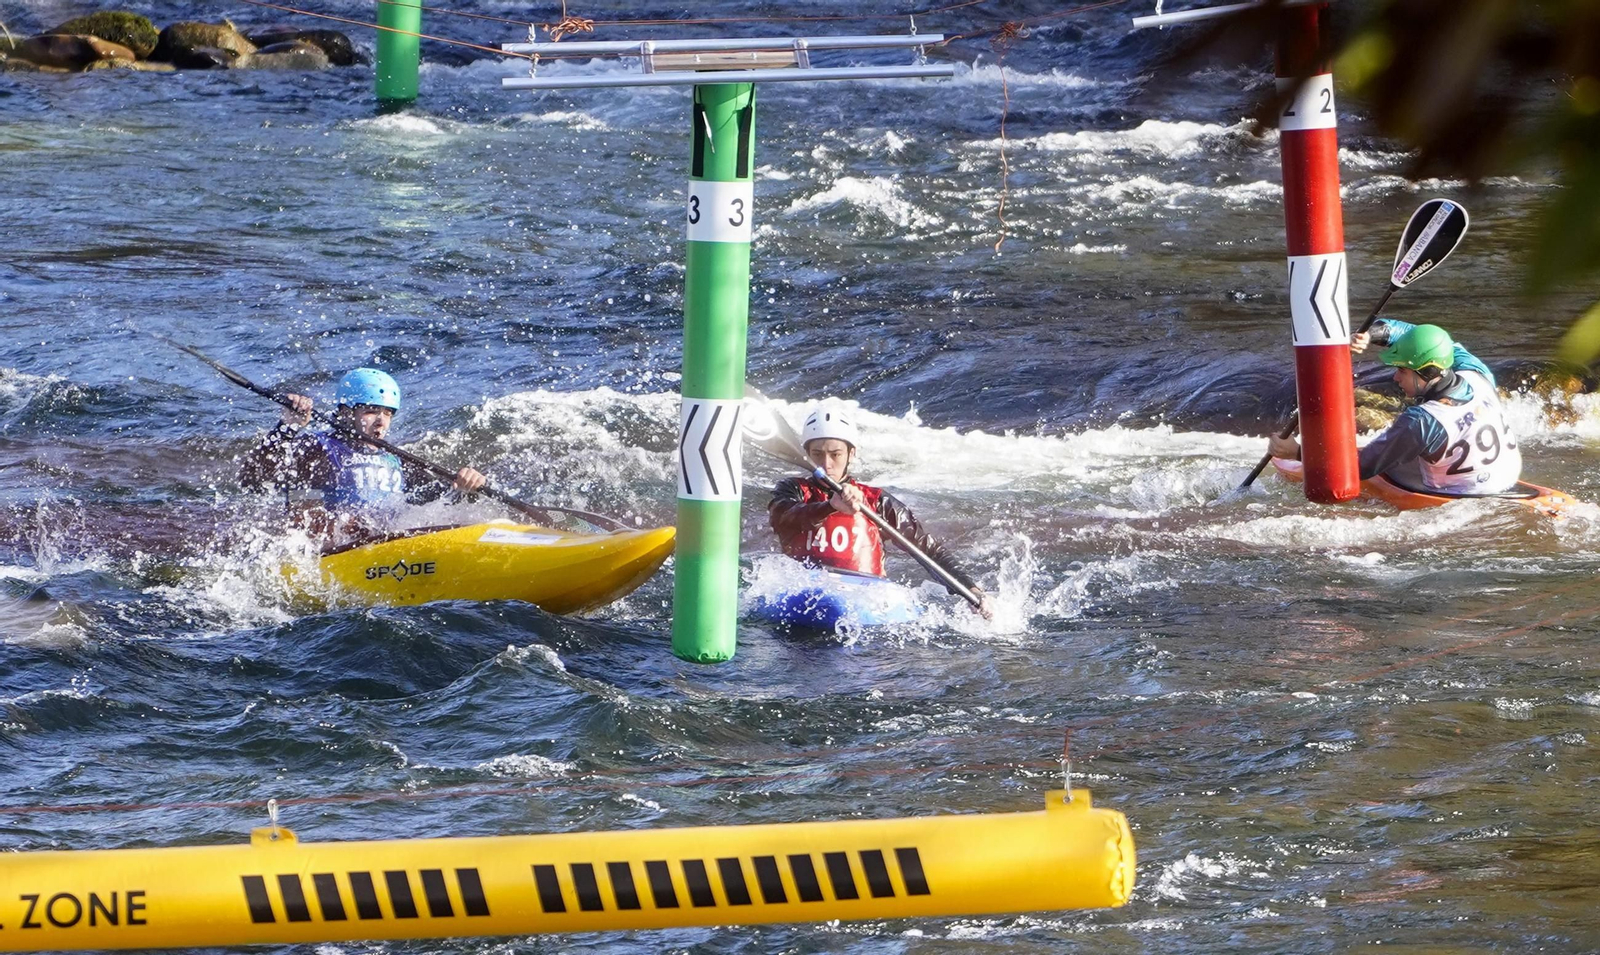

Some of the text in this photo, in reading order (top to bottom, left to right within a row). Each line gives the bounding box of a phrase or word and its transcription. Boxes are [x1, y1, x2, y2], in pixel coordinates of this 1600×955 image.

[1320, 87, 1332, 113] 2
[688, 194, 744, 227] 3 3
[806, 525, 866, 554] 1407
[19, 890, 147, 929] ZONE
